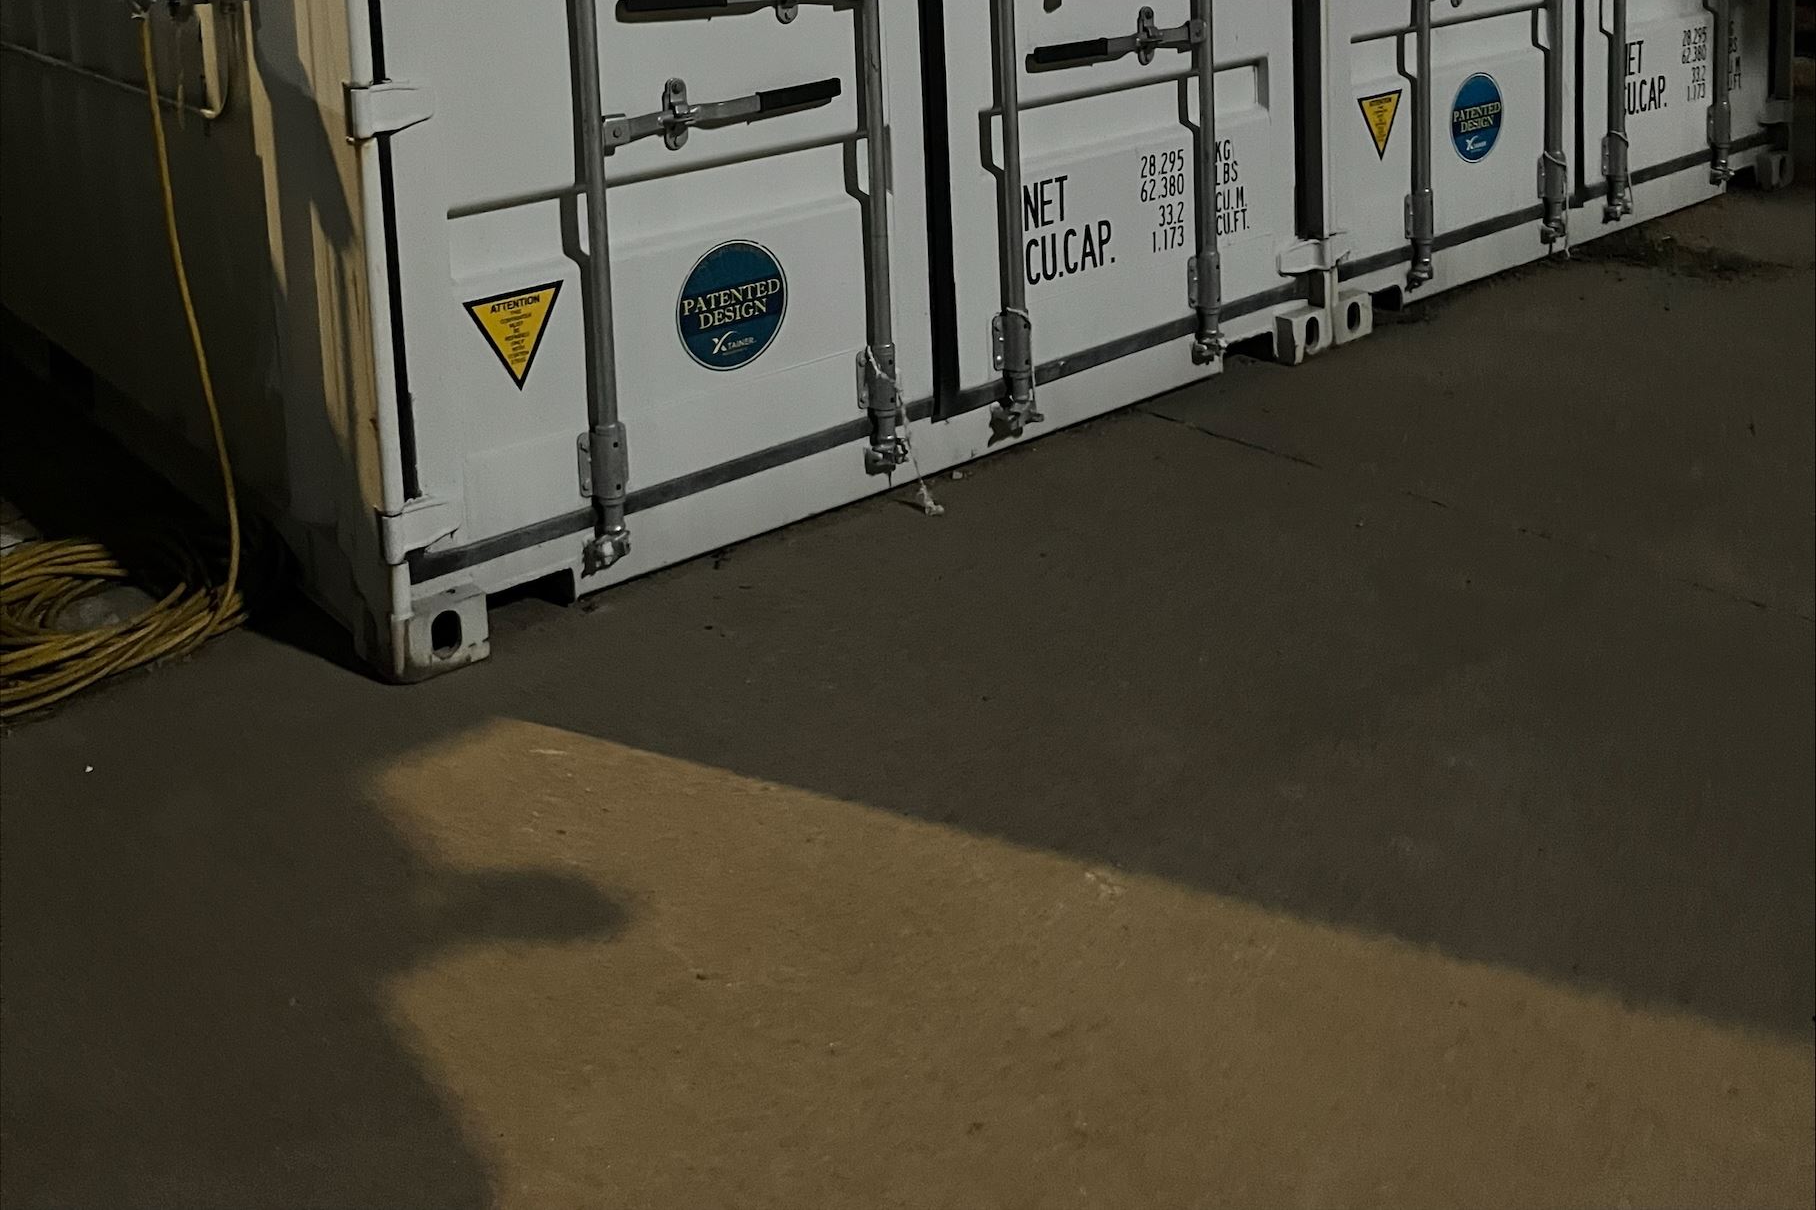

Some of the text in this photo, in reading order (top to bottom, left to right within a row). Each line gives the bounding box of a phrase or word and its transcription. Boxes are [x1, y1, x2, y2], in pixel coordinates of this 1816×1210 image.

[1453, 101, 1501, 123] PATENTED
[1624, 75, 1667, 115] U.CAP.
[1460, 115, 1495, 133] DESIGN
[1023, 139, 1231, 232] NET 28.295 KG
[1140, 173, 1185, 203] 62.380
[1025, 220, 1116, 286] CU.CAP.
[1159, 201, 1185, 227] 33.2
[1152, 208, 1250, 254] 1.173 CU.FT.
[490, 294, 540, 314] ATTENTION
[682, 278, 781, 316] PATENTED
[698, 298, 768, 330] DESIGN
